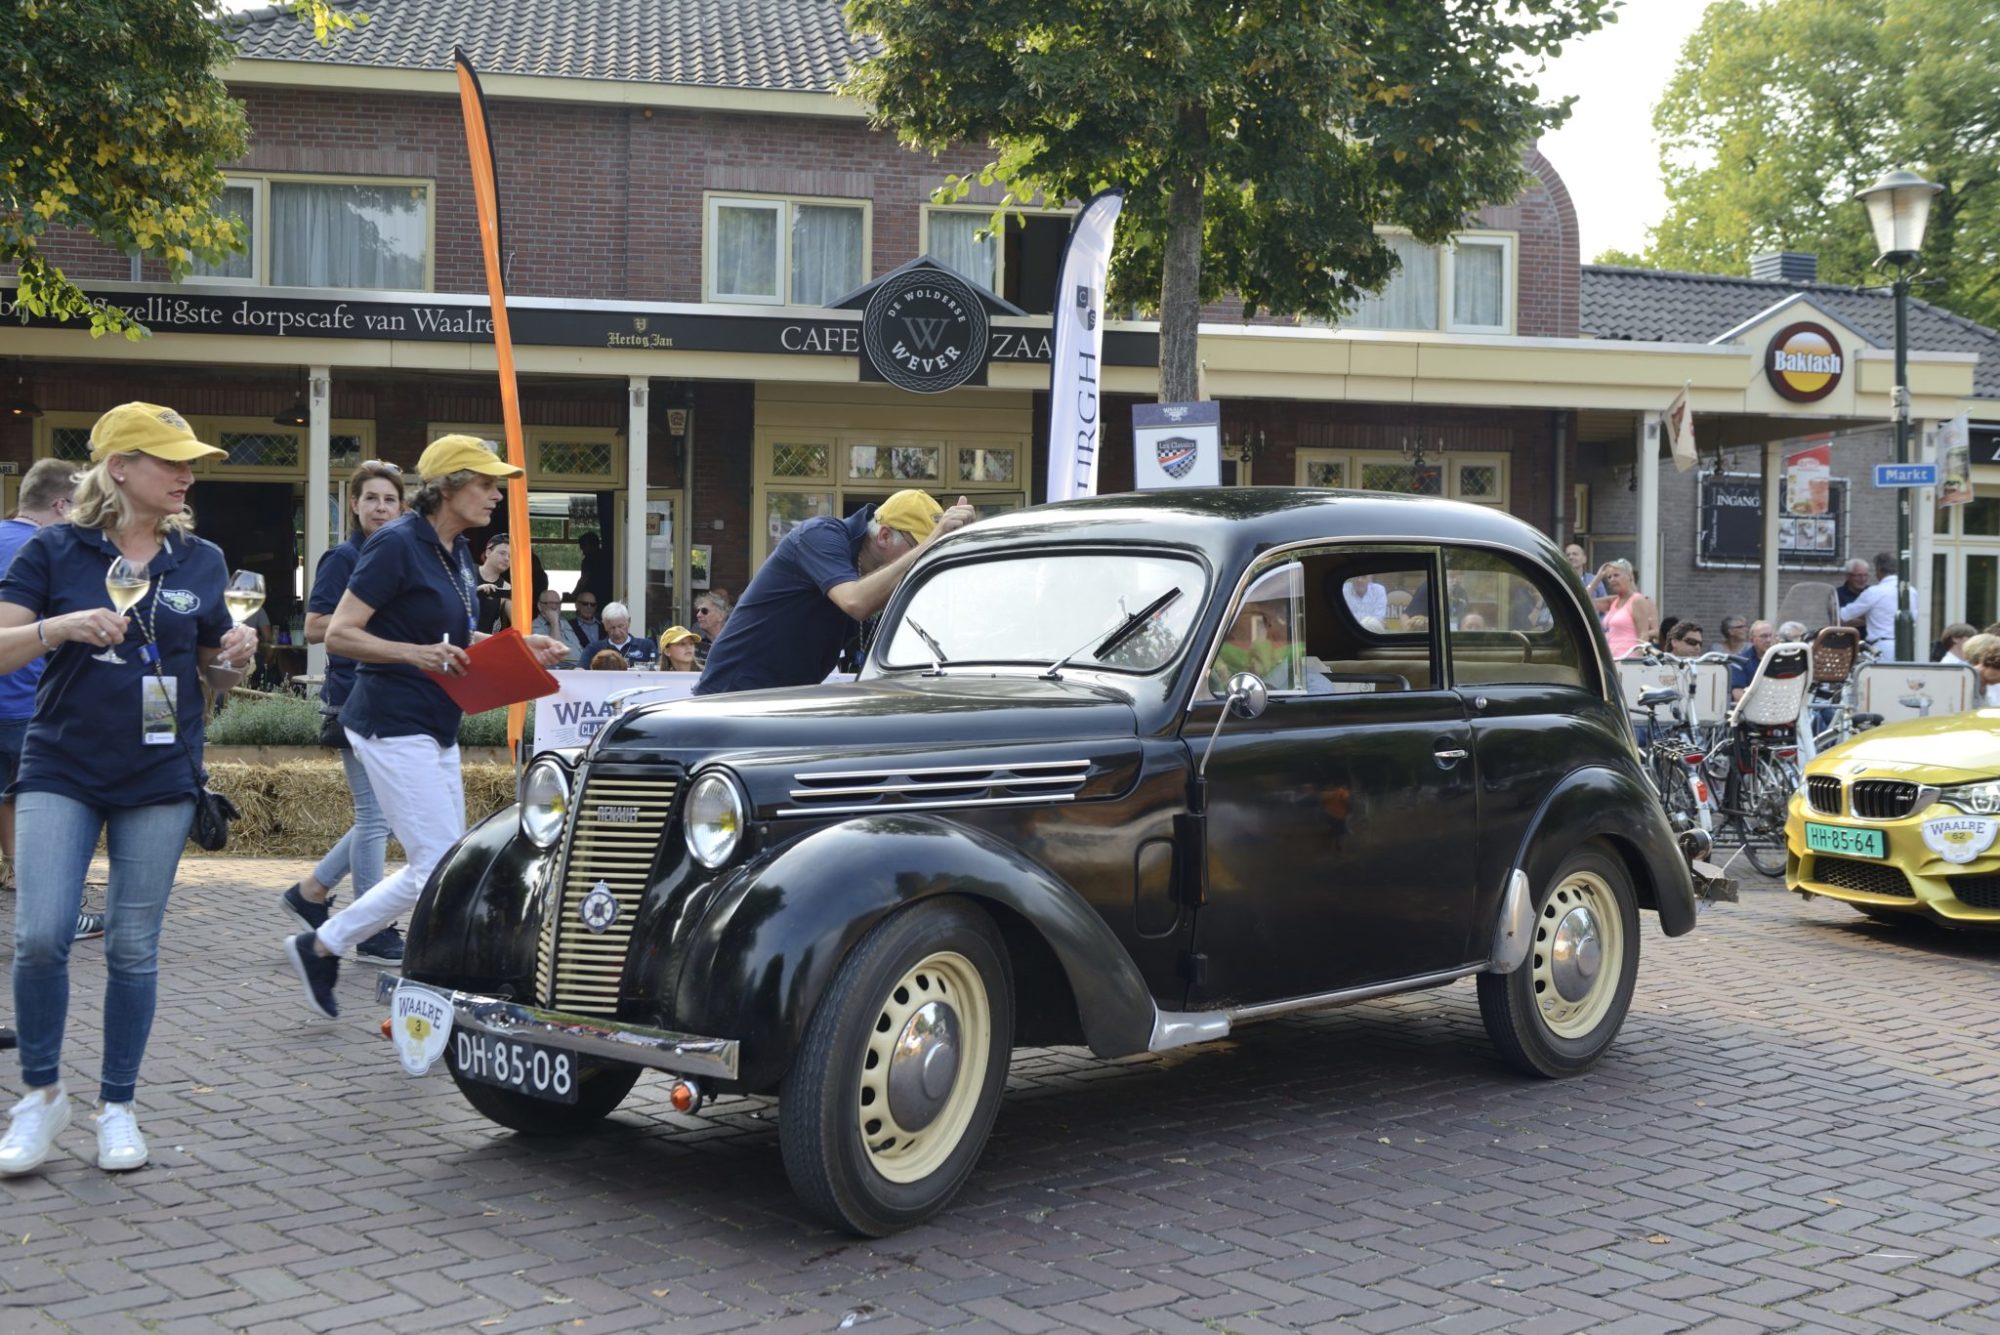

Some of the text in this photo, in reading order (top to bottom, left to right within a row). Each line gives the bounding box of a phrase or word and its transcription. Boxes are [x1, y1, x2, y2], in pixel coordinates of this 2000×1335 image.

[232, 301, 355, 335] dorpscafe
[364, 313, 406, 331] van
[411, 308, 495, 334] Waalre
[887, 289, 966, 324] DE WOLDERSE
[607, 332, 673, 350] Hertog Jan
[780, 325, 860, 353] CAFE
[891, 340, 961, 373] WEVER
[1774, 350, 1841, 374] Baktash
[1885, 469, 1929, 481] Markt
[1716, 495, 1761, 507] INGANG
[1811, 826, 1875, 853] HH-85-64
[1929, 820, 1986, 836] WAALRE
[1952, 832, 1966, 840] 62
[399, 997, 443, 1030] WAALRE
[415, 1020, 421, 1032] 3
